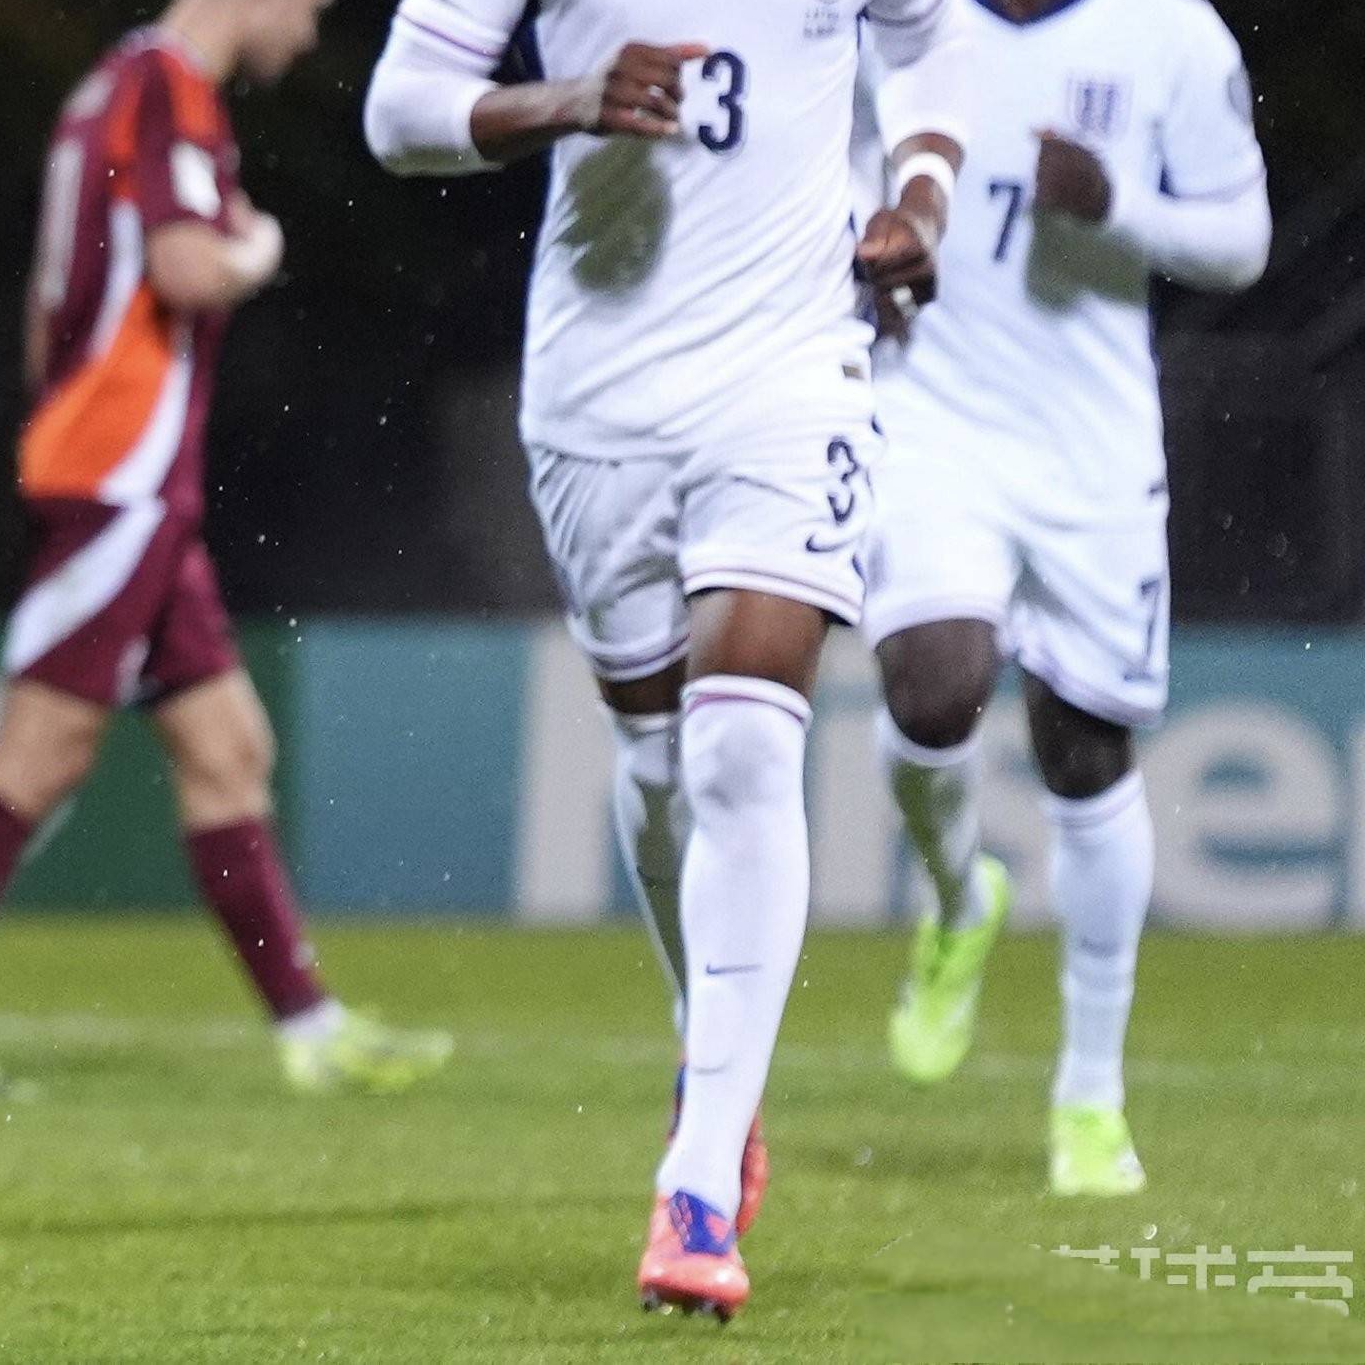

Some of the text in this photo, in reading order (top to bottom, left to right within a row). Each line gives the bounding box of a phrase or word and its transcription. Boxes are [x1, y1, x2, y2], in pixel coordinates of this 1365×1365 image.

[697, 49, 748, 156] 3
[988, 179, 1024, 262] 7
[826, 438, 861, 525] 3
